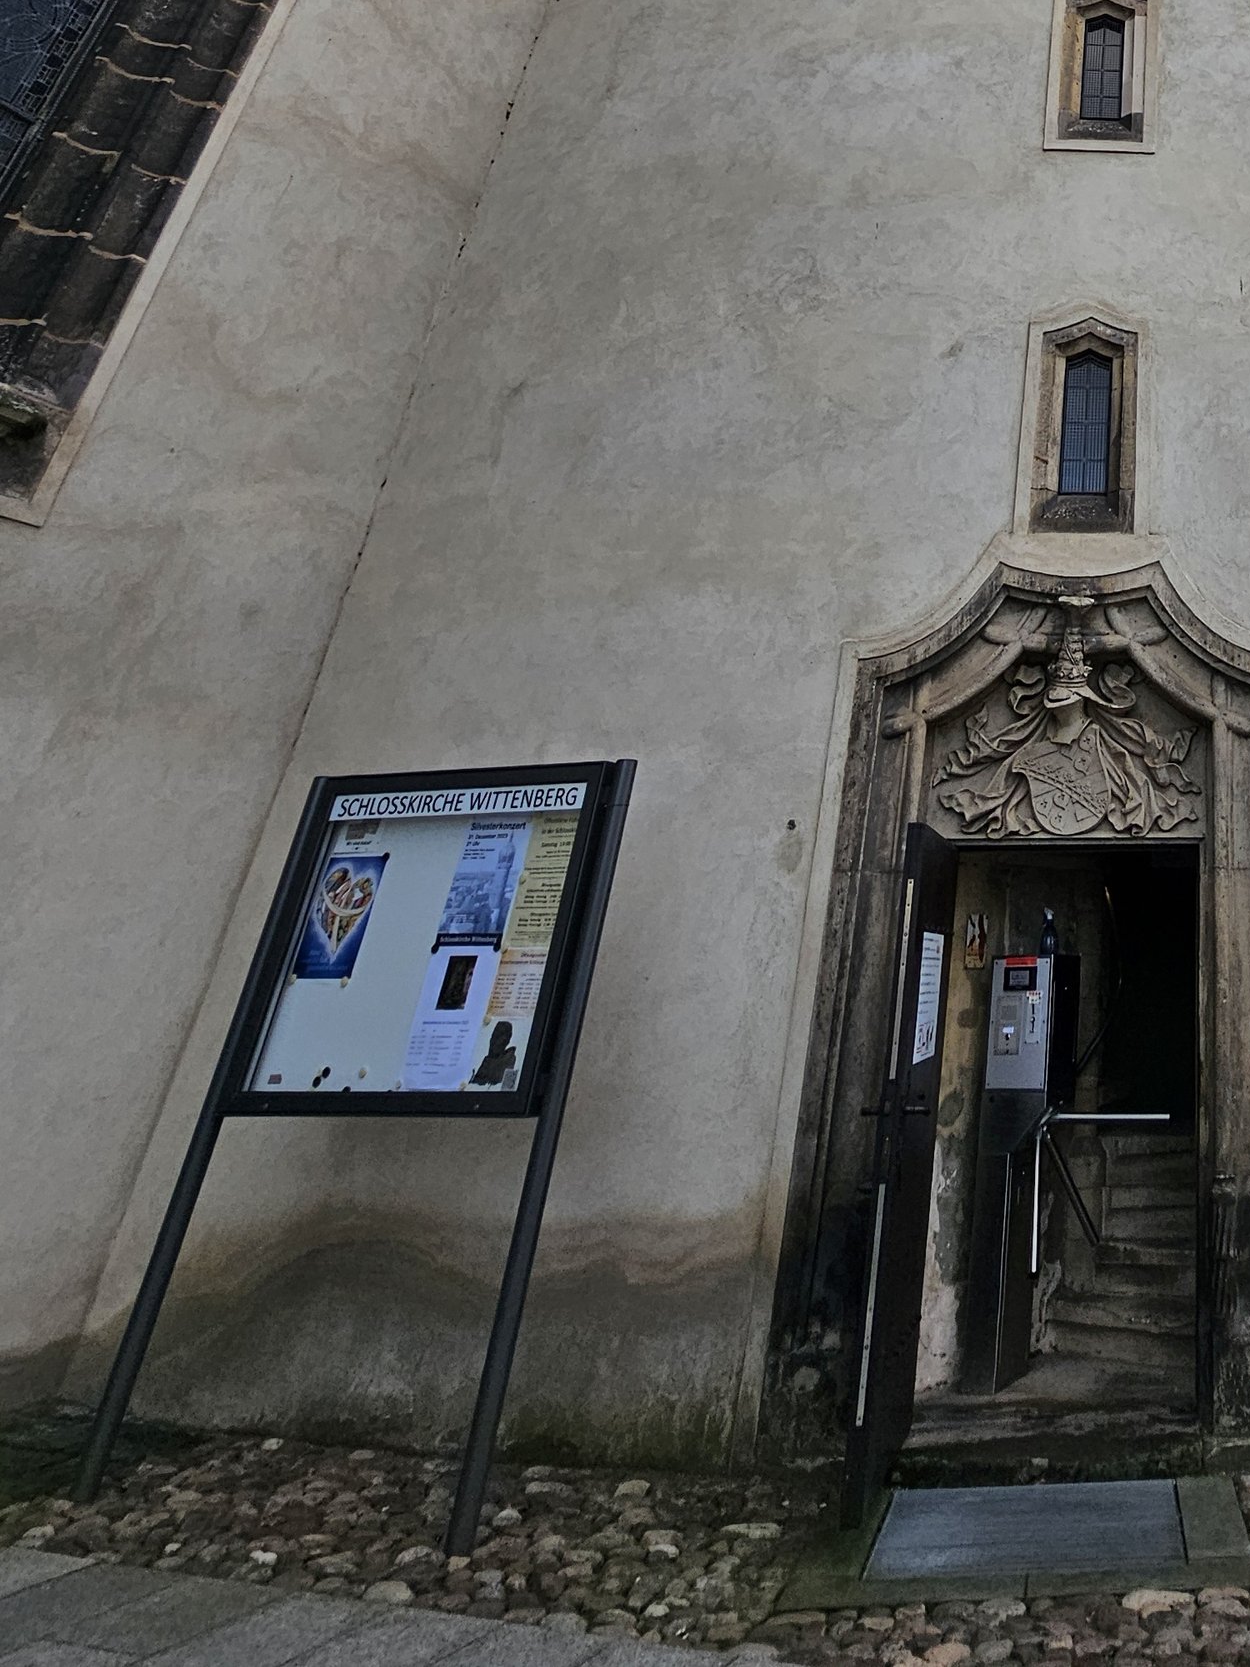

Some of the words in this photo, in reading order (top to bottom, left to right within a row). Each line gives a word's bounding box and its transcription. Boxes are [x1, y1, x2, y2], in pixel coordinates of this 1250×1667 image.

[337, 793, 466, 818] SCHLOSSKIRCHE
[469, 787, 579, 811] WITTENBERG
[470, 822, 527, 831] Silvesterkonzert
